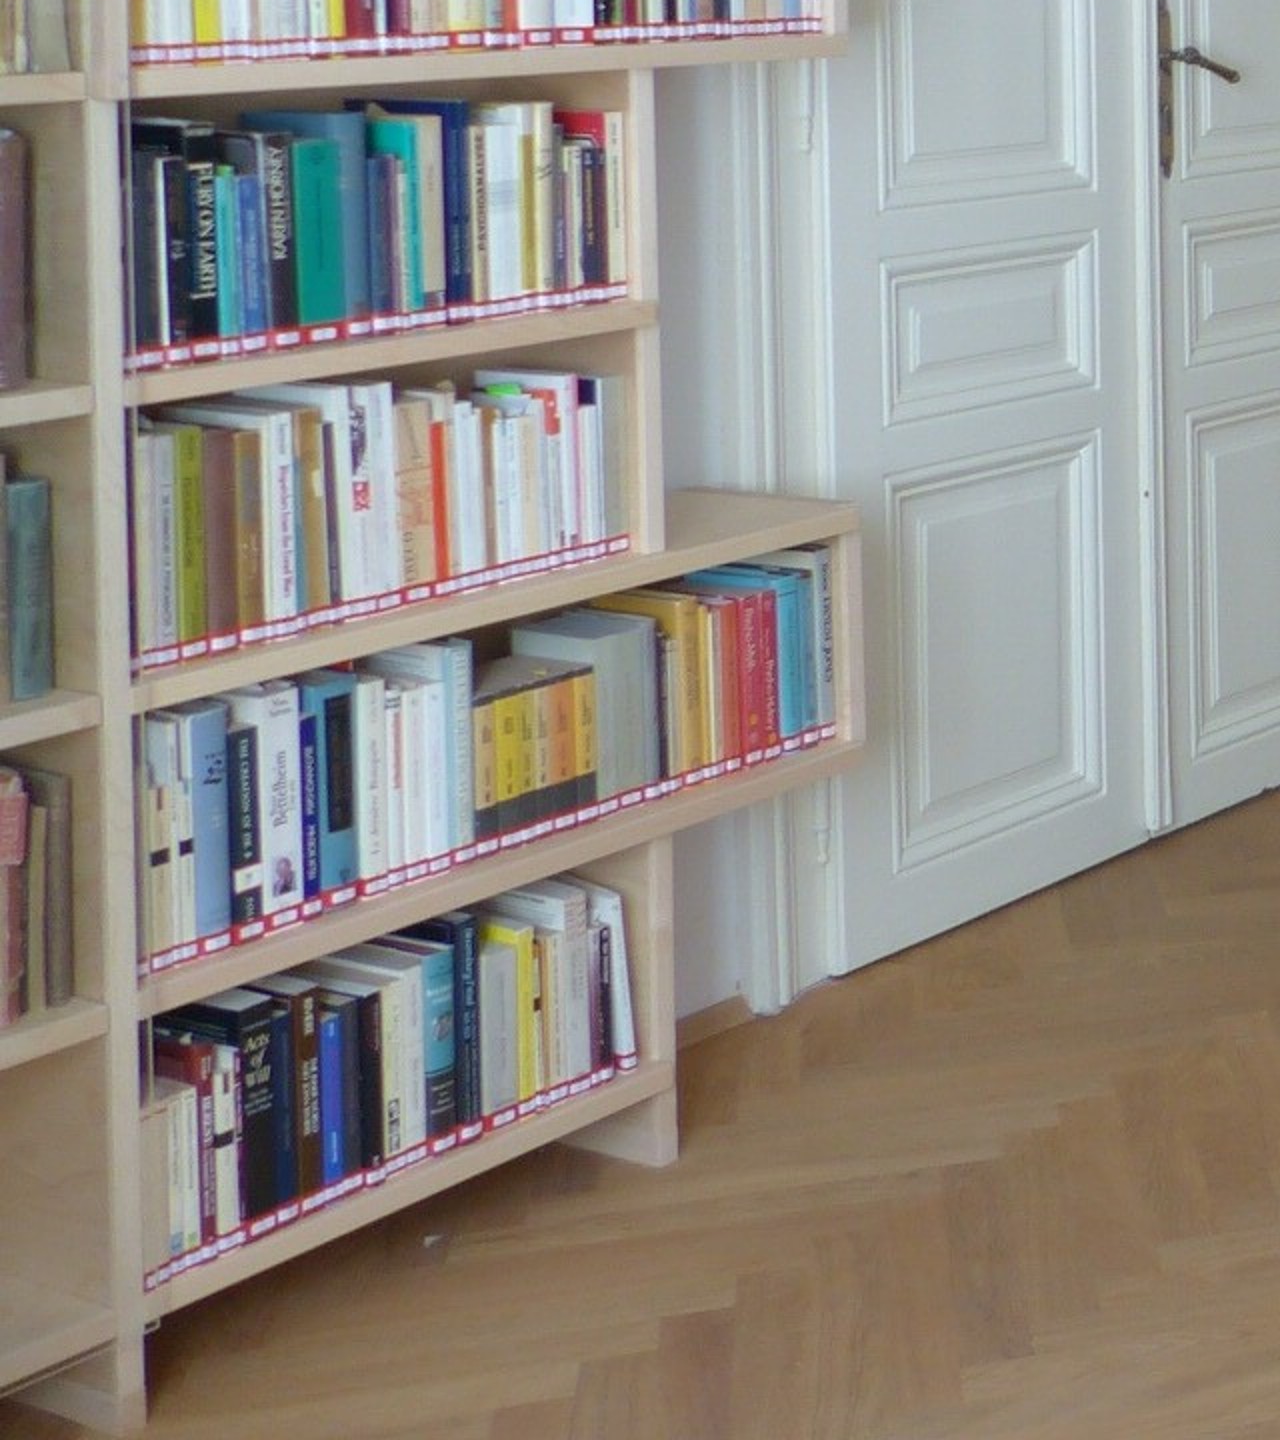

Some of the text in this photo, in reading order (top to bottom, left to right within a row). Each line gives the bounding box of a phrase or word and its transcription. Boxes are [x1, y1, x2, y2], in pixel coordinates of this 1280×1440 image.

[187, 162, 217, 299] FURY ON EARTH
[267, 146, 287, 259] KAREN HORNEY
[273, 750, 289, 828] Bettelheim
[245, 1031, 272, 1052] Acts
[250, 1048, 266, 1067] of
